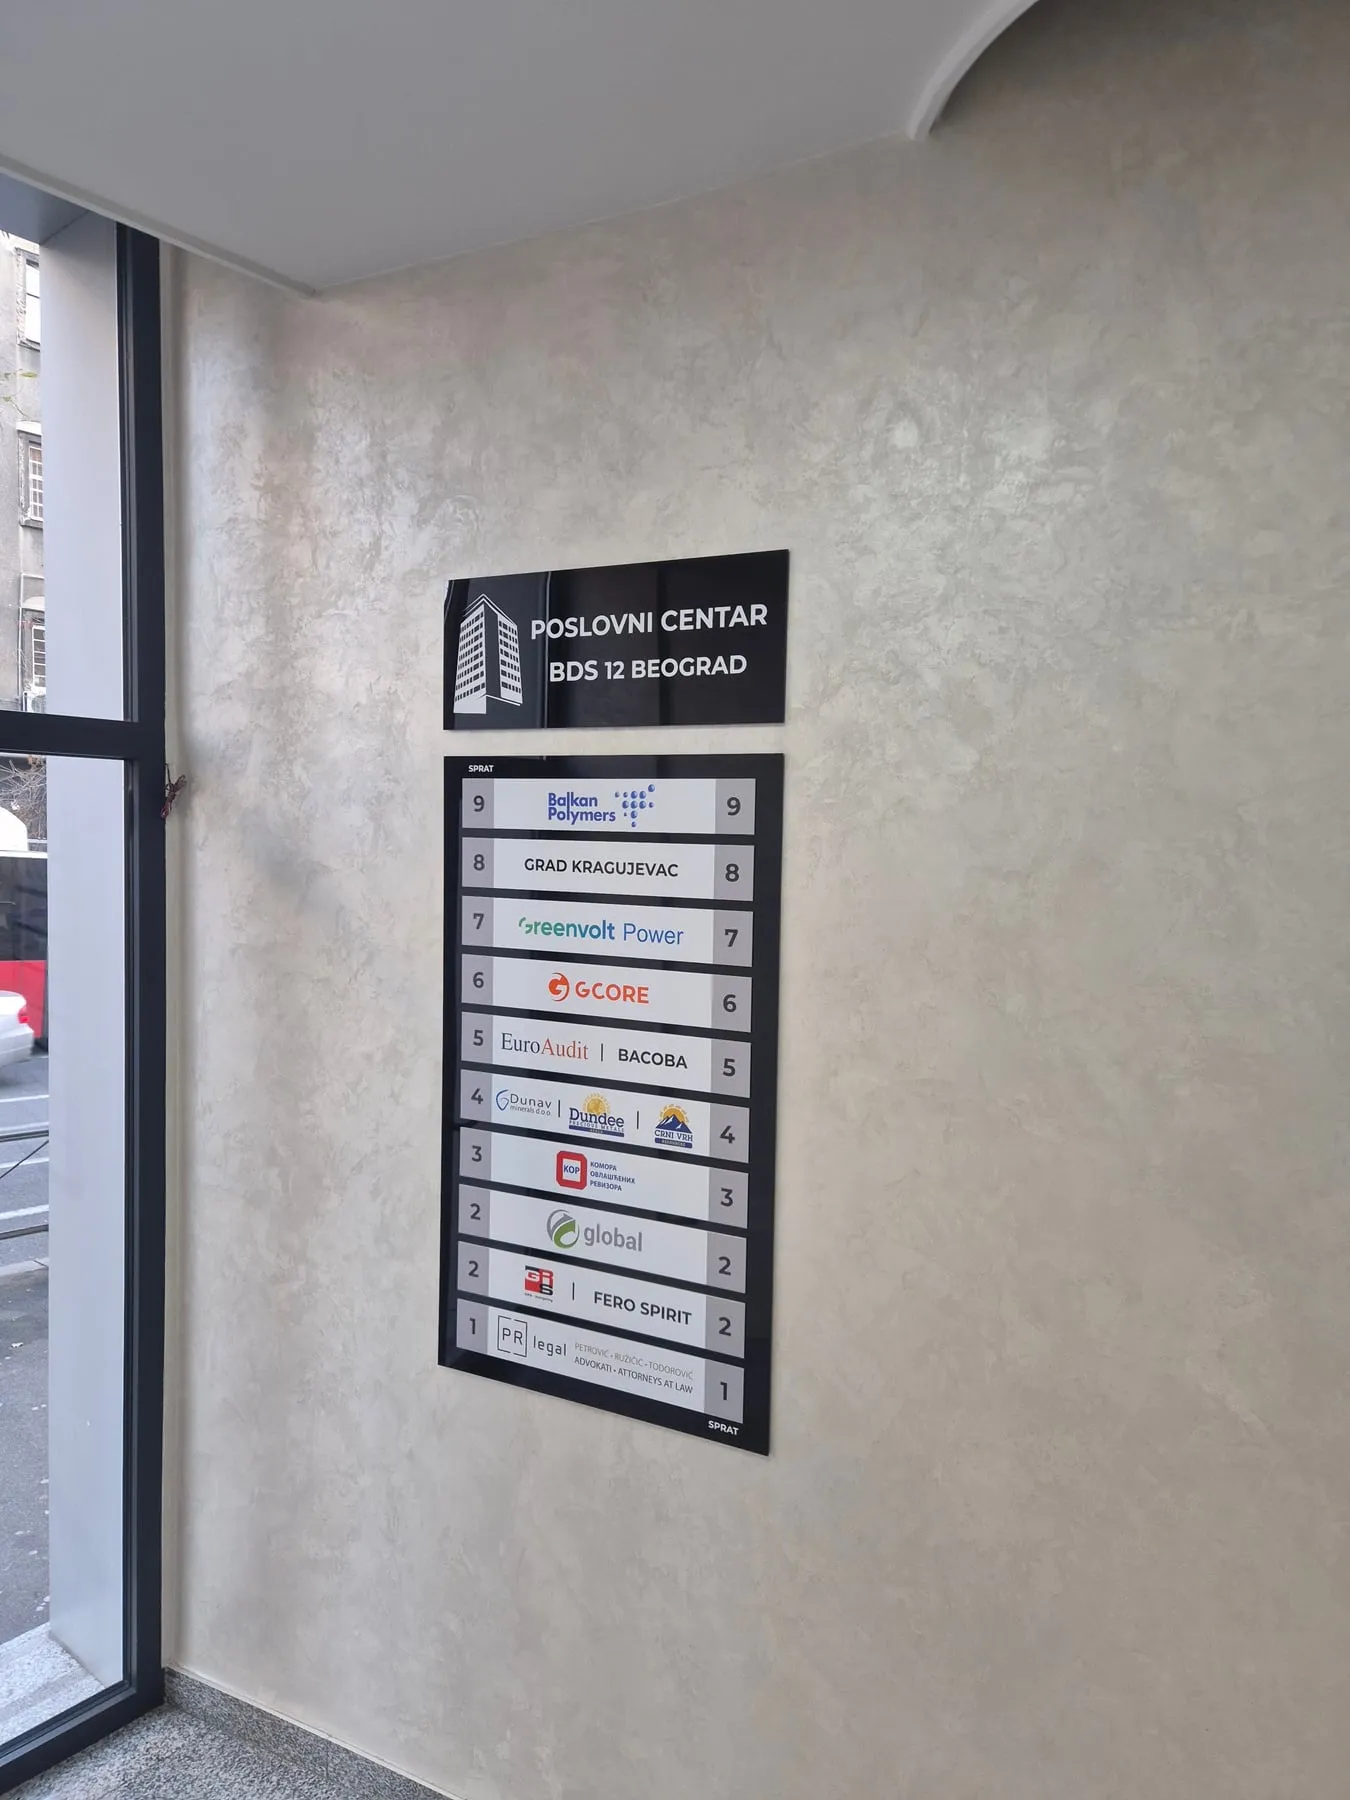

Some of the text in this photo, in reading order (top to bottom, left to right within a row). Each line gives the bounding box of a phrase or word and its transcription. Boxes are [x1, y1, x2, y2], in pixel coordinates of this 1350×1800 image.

[531, 603, 769, 640] POSLOVNI CENTAR
[549, 654, 748, 682] BDS 12 BEOGRAD
[468, 764, 494, 773] SPRAT
[473, 795, 485, 812] 9
[547, 791, 598, 808] Balkan
[726, 797, 742, 816] 9
[547, 806, 616, 825] Polymers
[473, 854, 485, 871] 8
[524, 858, 679, 878] GRAD KRAGUJEVAC
[725, 863, 740, 882] 8
[473, 913, 485, 930] 7
[518, 916, 685, 946] Greenvolt Power
[724, 928, 739, 947] 7
[472, 972, 485, 989] 6
[574, 981, 650, 1004] GCORE
[722, 994, 737, 1013] 6
[472, 1030, 484, 1047] 5
[617, 1048, 689, 1069] BACOBA
[722, 1058, 736, 1077] 5
[470, 1087, 484, 1105] 4
[510, 1093, 552, 1109] Dunav
[509, 1105, 535, 1115] minerals
[568, 1107, 625, 1128] Dundee
[654, 1129, 694, 1142] CRNI VRH
[719, 1125, 735, 1144] 4
[471, 1145, 482, 1162] 3
[590, 1161, 618, 1171] КОМОРА
[589, 1180, 623, 1192] РЕВИЗОРА
[720, 1188, 734, 1207] 3
[470, 1203, 481, 1221] 2
[584, 1223, 643, 1252] global
[468, 1260, 479, 1278] 2
[718, 1256, 732, 1276] 2
[593, 1291, 693, 1325] FERO SPIRIT
[469, 1317, 477, 1335] 1
[718, 1316, 732, 1336] 2
[502, 1327, 567, 1356] PR legal
[574, 1342, 610, 1359] PETROVIĆ
[574, 1356, 693, 1394] ADVOKATI ATTORNEYS AT LAW
[719, 1381, 729, 1401] 1
[707, 1420, 740, 1436] SPRAT
